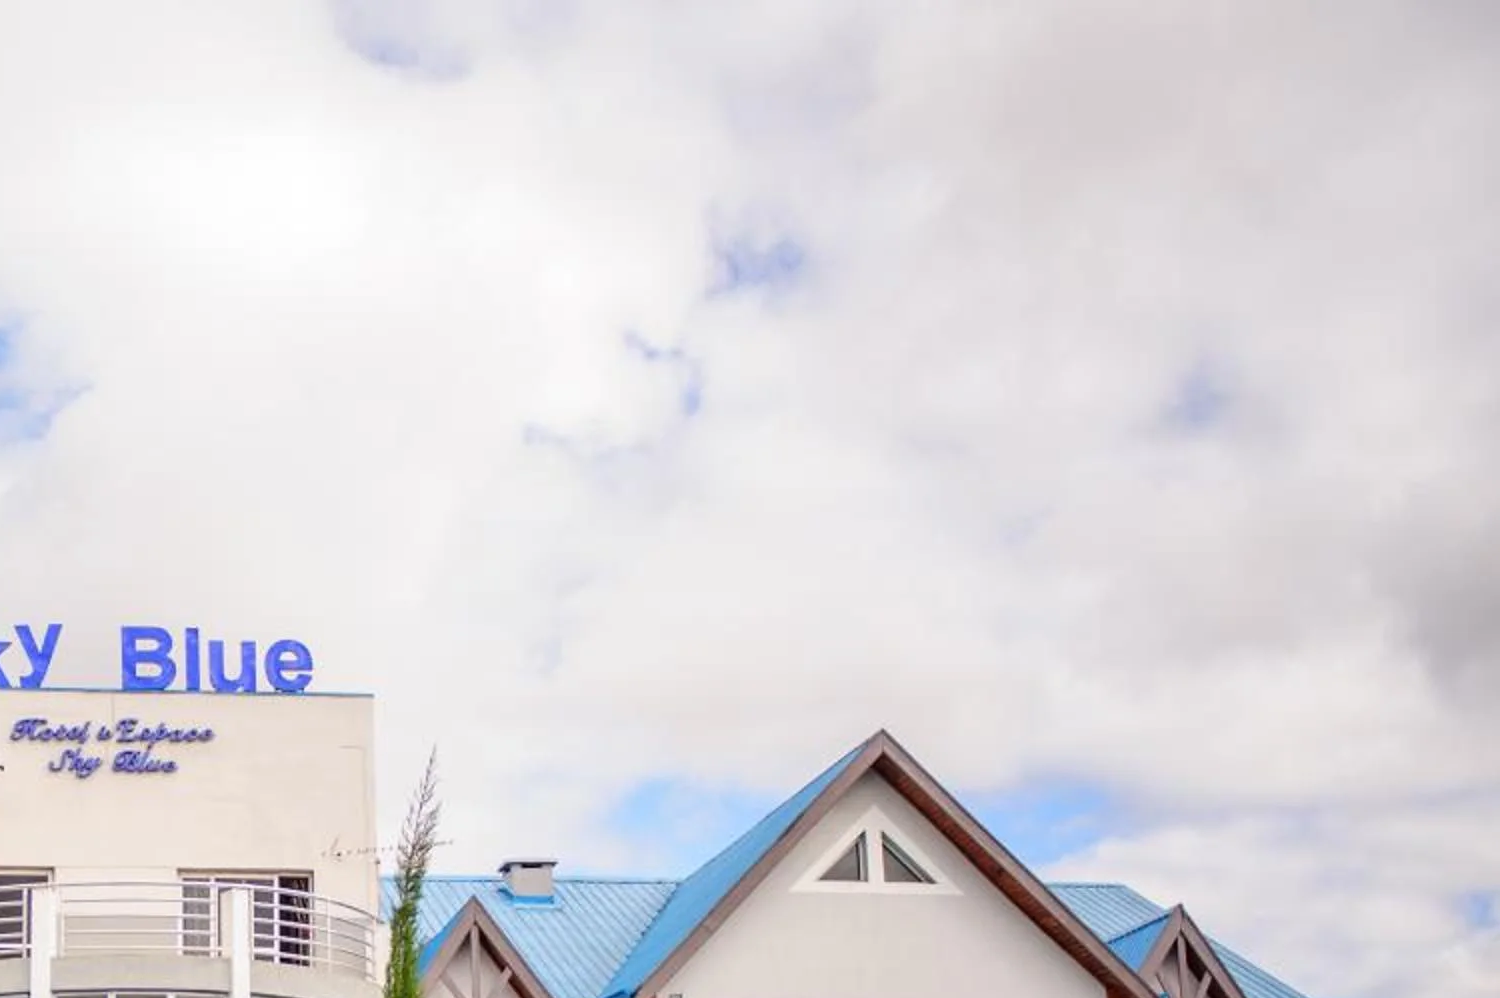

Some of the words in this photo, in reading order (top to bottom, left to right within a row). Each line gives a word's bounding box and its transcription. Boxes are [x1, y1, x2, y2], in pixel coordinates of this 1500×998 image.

[120, 625, 315, 693] Blue
[49, 748, 102, 778] Sky
[112, 748, 178, 772] Blue
